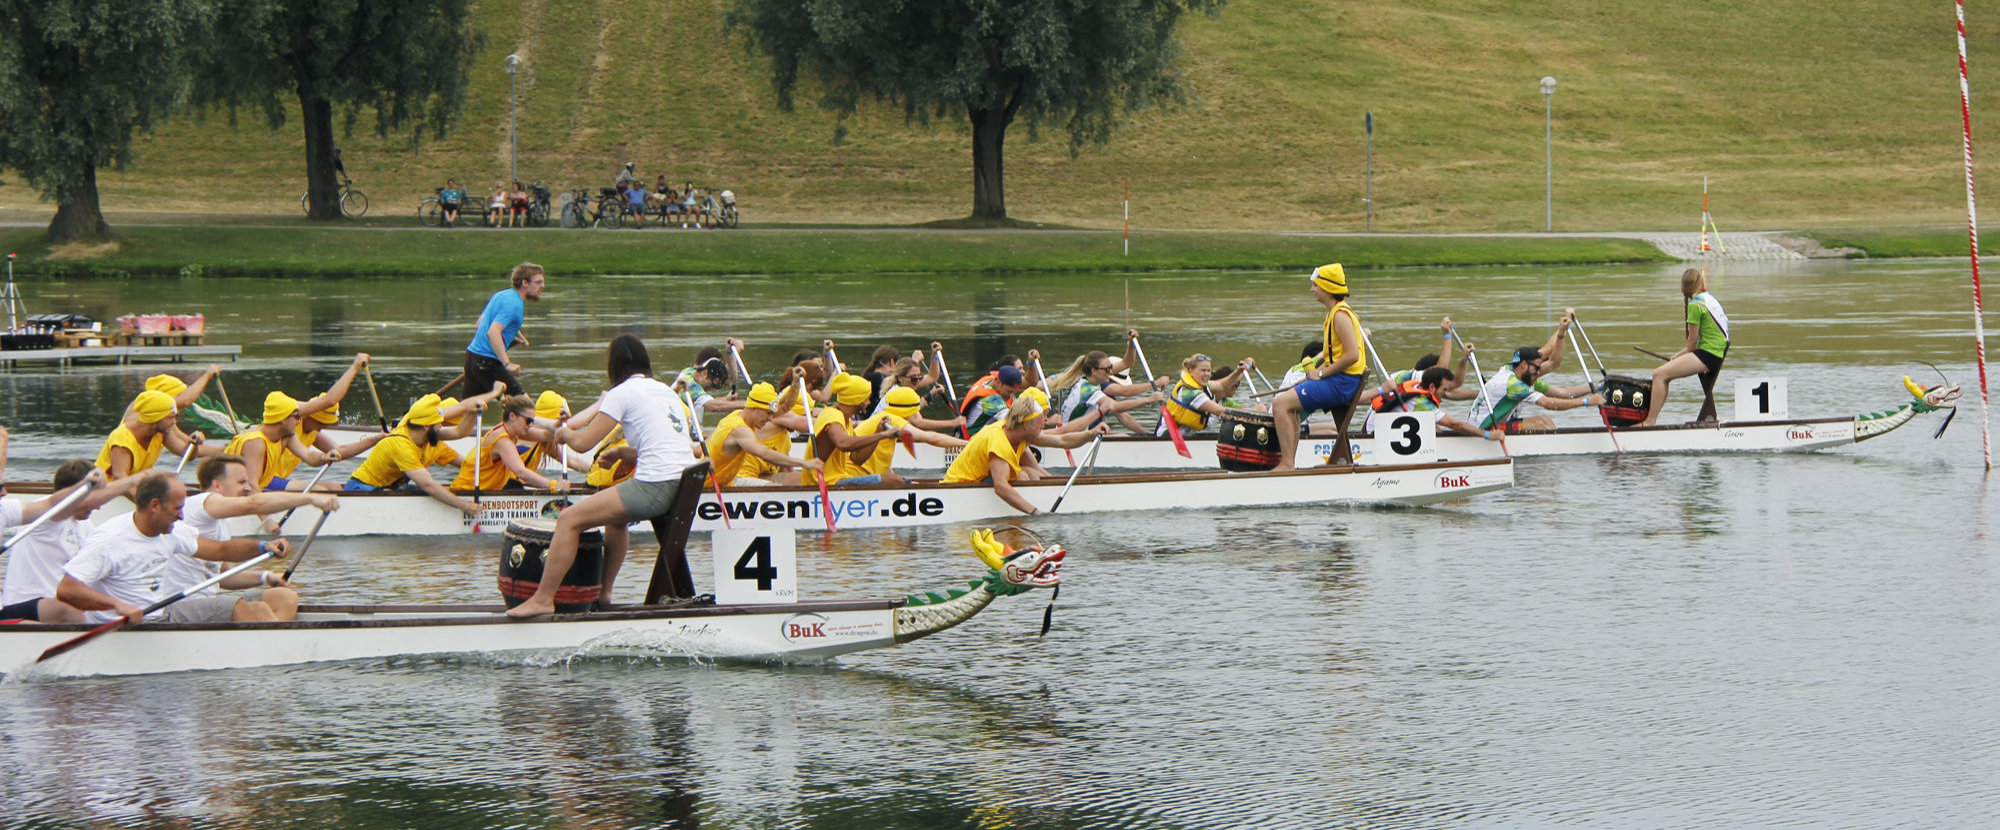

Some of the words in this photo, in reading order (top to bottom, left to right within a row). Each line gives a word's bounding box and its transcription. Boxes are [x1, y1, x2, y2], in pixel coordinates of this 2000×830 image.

[1751, 381, 1769, 414] 1
[1390, 415, 1421, 456] 3
[1791, 430, 1813, 439] BuK
[1440, 475, 1470, 488] BuK
[490, 511, 504, 519] UND
[507, 511, 539, 519] TRAINING
[734, 536, 777, 591] 4
[789, 622, 826, 638] BuK
